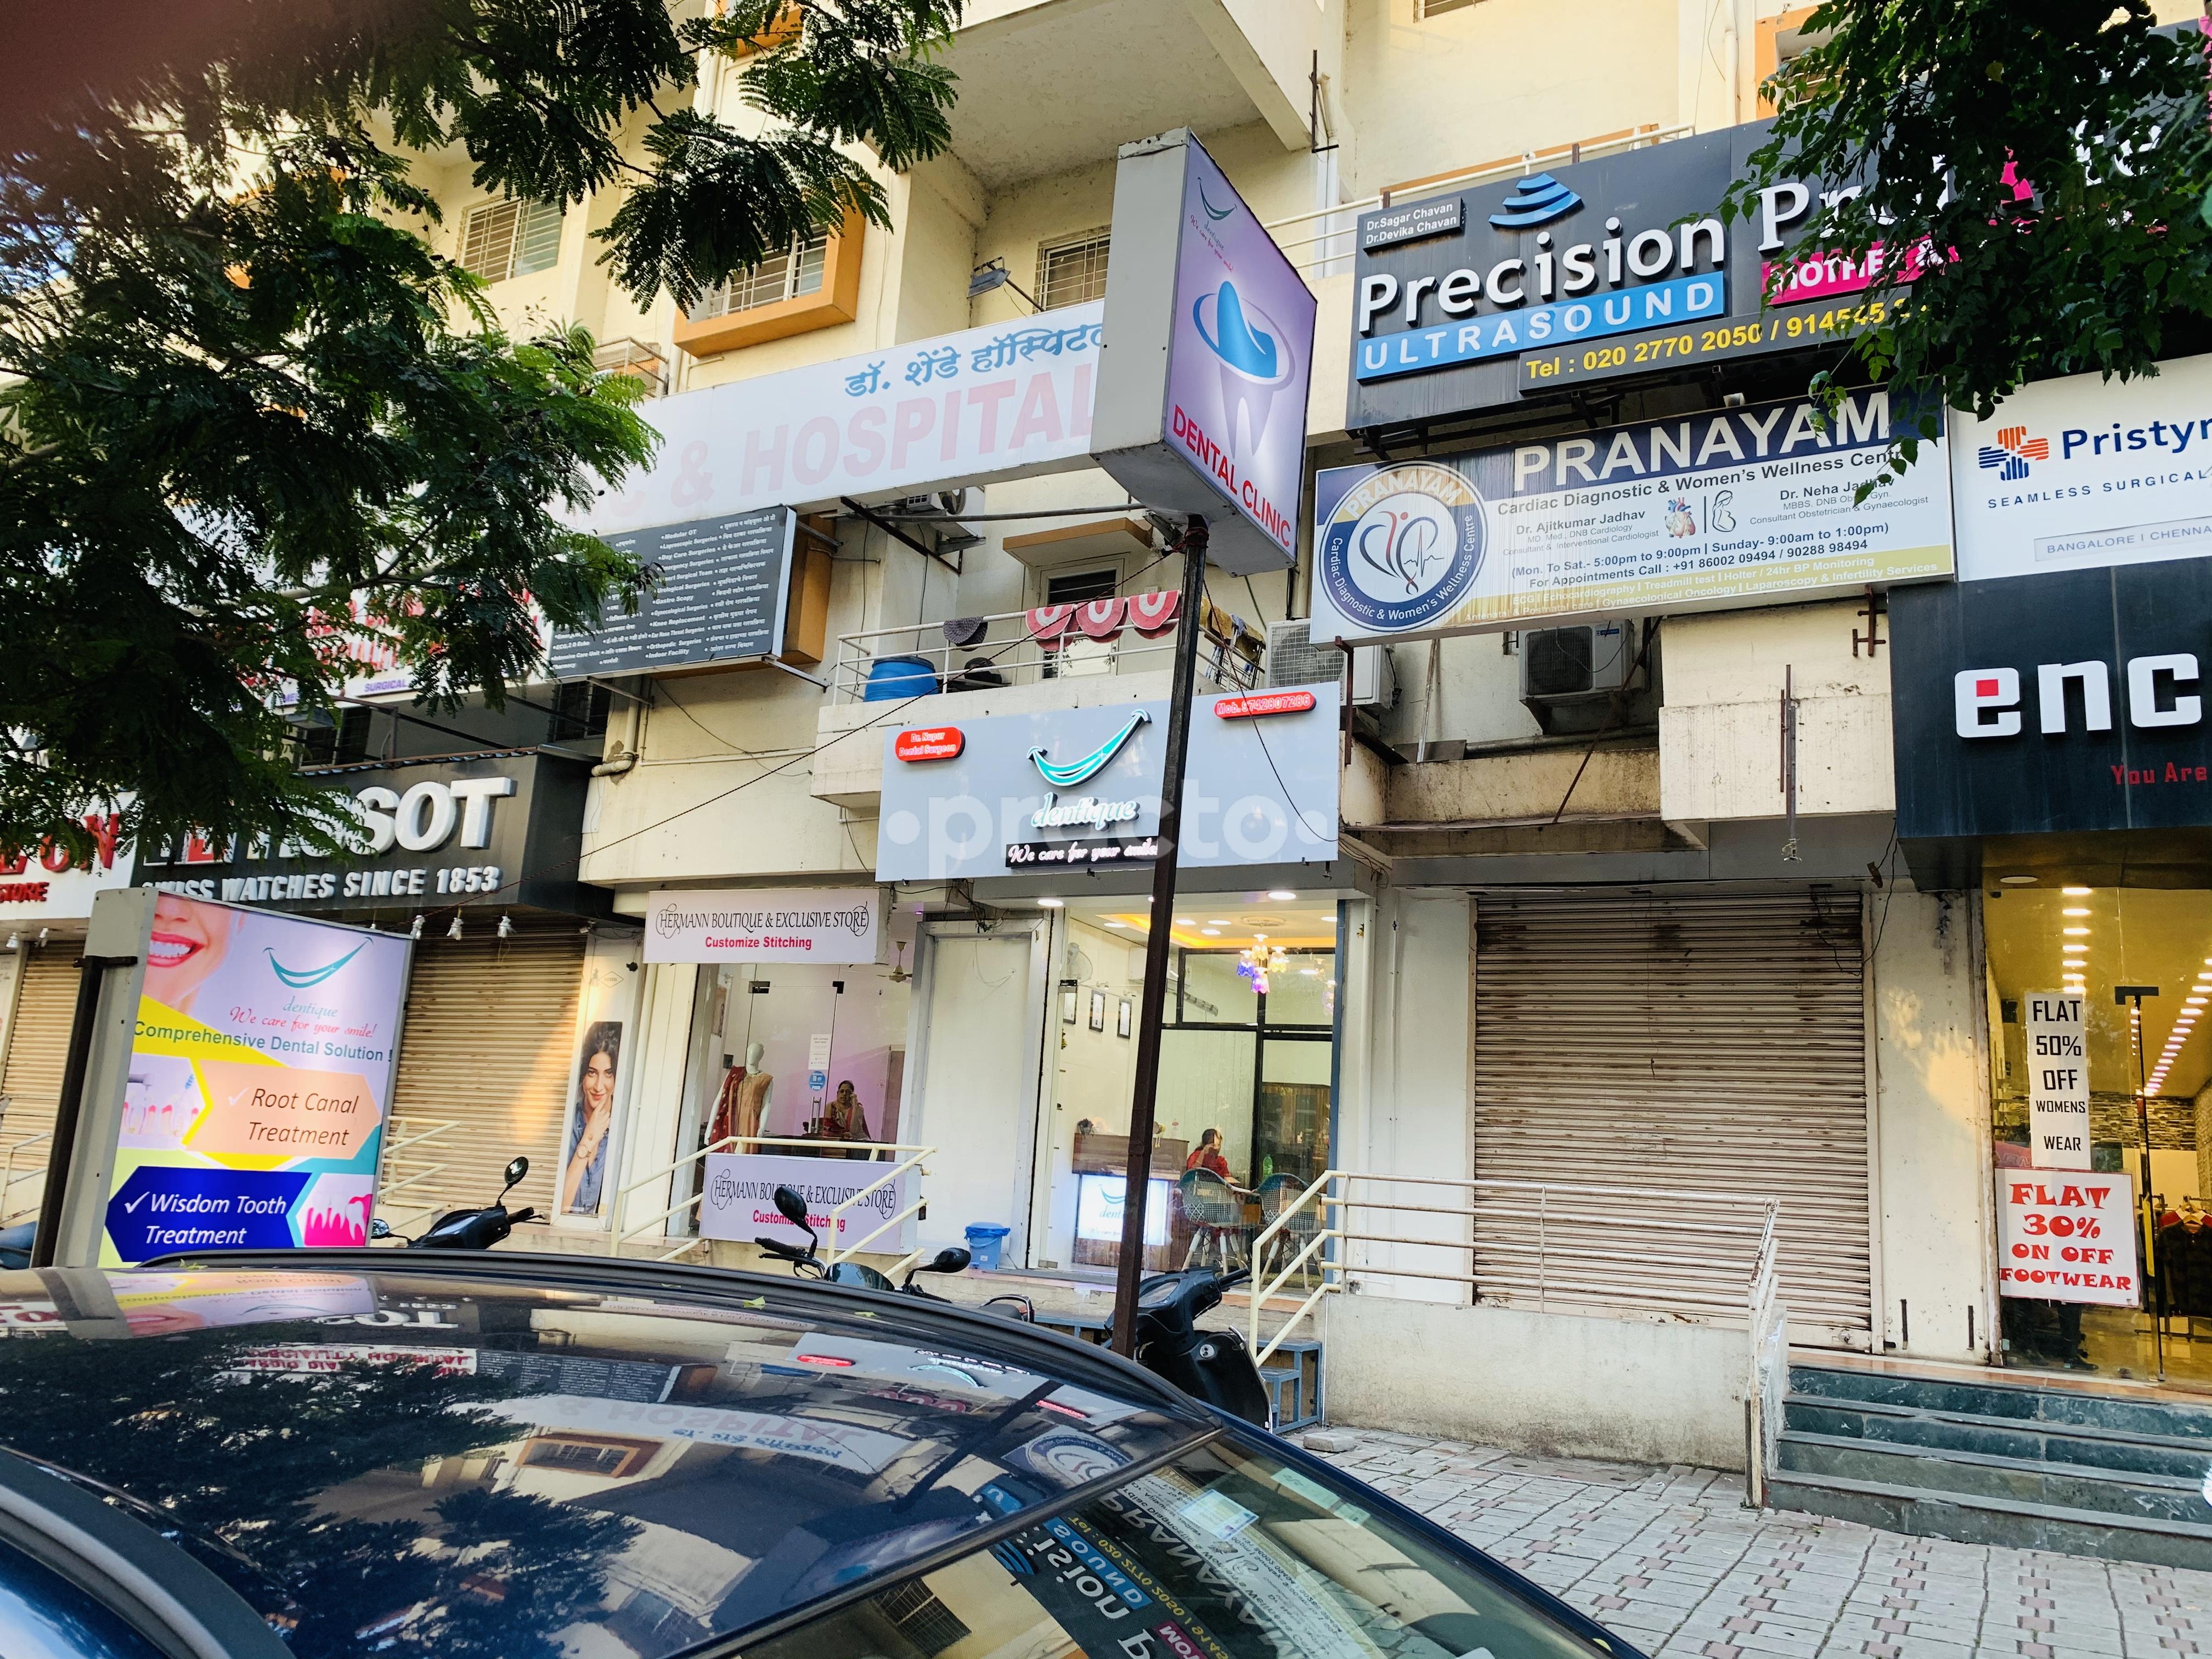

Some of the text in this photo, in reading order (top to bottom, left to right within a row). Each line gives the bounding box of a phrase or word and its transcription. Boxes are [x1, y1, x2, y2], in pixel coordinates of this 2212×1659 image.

[1367, 203, 1453, 231] Dr.Sagar Chavan
[1366, 216, 1457, 245] Dr.Devika Chavan
[1359, 217, 1725, 335] Precision
[1364, 282, 1714, 370] ULTRASOUND
[1526, 358, 1560, 380] Tel
[1583, 346, 1626, 370] 020
[1633, 337, 1694, 363] 2770
[1701, 324, 1761, 352] 2050
[740, 363, 1097, 496] HOSPITAL
[1514, 392, 1891, 493] PRANAYAM
[1173, 404, 1290, 548] DENTAL CLINIC
[1498, 449, 1903, 515] Cardiac Diagnostic & Women's Wellness Centr
[1344, 472, 1463, 518] PRANAYAM
[1780, 486, 1839, 500] Dr. Neha
[1783, 500, 1813, 511] MBBS,
[1816, 496, 1837, 506] DNB
[1870, 491, 1891, 500] Gyn.
[1988, 470, 2207, 509] SEAMLESS SURGICAL
[1516, 511, 1645, 535] Dr. Ajitkumar Jadhav
[1750, 512, 1796, 524] Consultant
[1798, 506, 1852, 518] Obstetrician
[1863, 496, 1928, 512] Gynaecologist
[1503, 530, 1659, 556] Consultant Interventional Cardiologist
[1570, 529, 1588, 538] DNB
[1590, 524, 1633, 536] Cardiology
[2047, 534, 2135, 554] BANGALORE
[1512, 567, 1543, 579] (Mon.
[1547, 563, 1560, 573] To
[1594, 555, 1637, 567] 5:00pm
[1641, 552, 1652, 561] to
[1656, 546, 1701, 560] 9:00pm
[1768, 532, 1814, 545] 9:00am
[1818, 529, 1831, 539] to
[1836, 522, 1889, 537] 1:00pm)
[1530, 539, 1868, 588] For Appointments Call +91 86002 09494 90288 98494
[1330, 514, 1475, 620] Cardiac Diagnostic & Women's Wellness Centre
[1465, 562, 1937, 622] Antenatal Postnatal care Gynaecological Oncology Laparoscopy & Infertility Services
[1513, 557, 1875, 605] ECG Echocardiography Treadmill test Holter 24hr BP Monitoring
[2111, 762, 2207, 785] You Are
[1030, 791, 1139, 831] dentique
[1008, 844, 1035, 864] We
[1038, 849, 1064, 861] care
[1067, 841, 1088, 864] for
[1091, 846, 1121, 862] your
[222, 872, 336, 902] WATCHES
[343, 868, 426, 898] SINCE
[437, 865, 501, 895] 1853
[658, 908, 868, 933] HERMANN BOUTIQUE & EXCLUSIVE STORE
[705, 935, 812, 950] Customize Stitching
[282, 995, 339, 1019] dentique
[2033, 1000, 2082, 1022] FLAT
[229, 1005, 256, 1025] We
[261, 1014, 287, 1029] care
[290, 1014, 310, 1032] for
[313, 1022, 341, 1037] your
[133, 1020, 383, 1062] Comprehensive Dental Solution
[2036, 1035, 2083, 1056] 50%
[2043, 1069, 2078, 1091] OFF
[251, 1087, 360, 1115] Root Canal
[2036, 1100, 2086, 1114] WOMENS
[247, 1121, 350, 1146] Treatment
[2043, 1136, 2081, 1152] WEAR
[713, 1177, 758, 1204] HERMANN
[2010, 1183, 2111, 1209] FLAT
[150, 1193, 288, 1215] Wisdom Tooth
[144, 1225, 247, 1245] Treatment
[2022, 1214, 2101, 1239] 30%
[2011, 1243, 2114, 1265] ON OFF
[1999, 1267, 2132, 1291] FOOTWEAR
